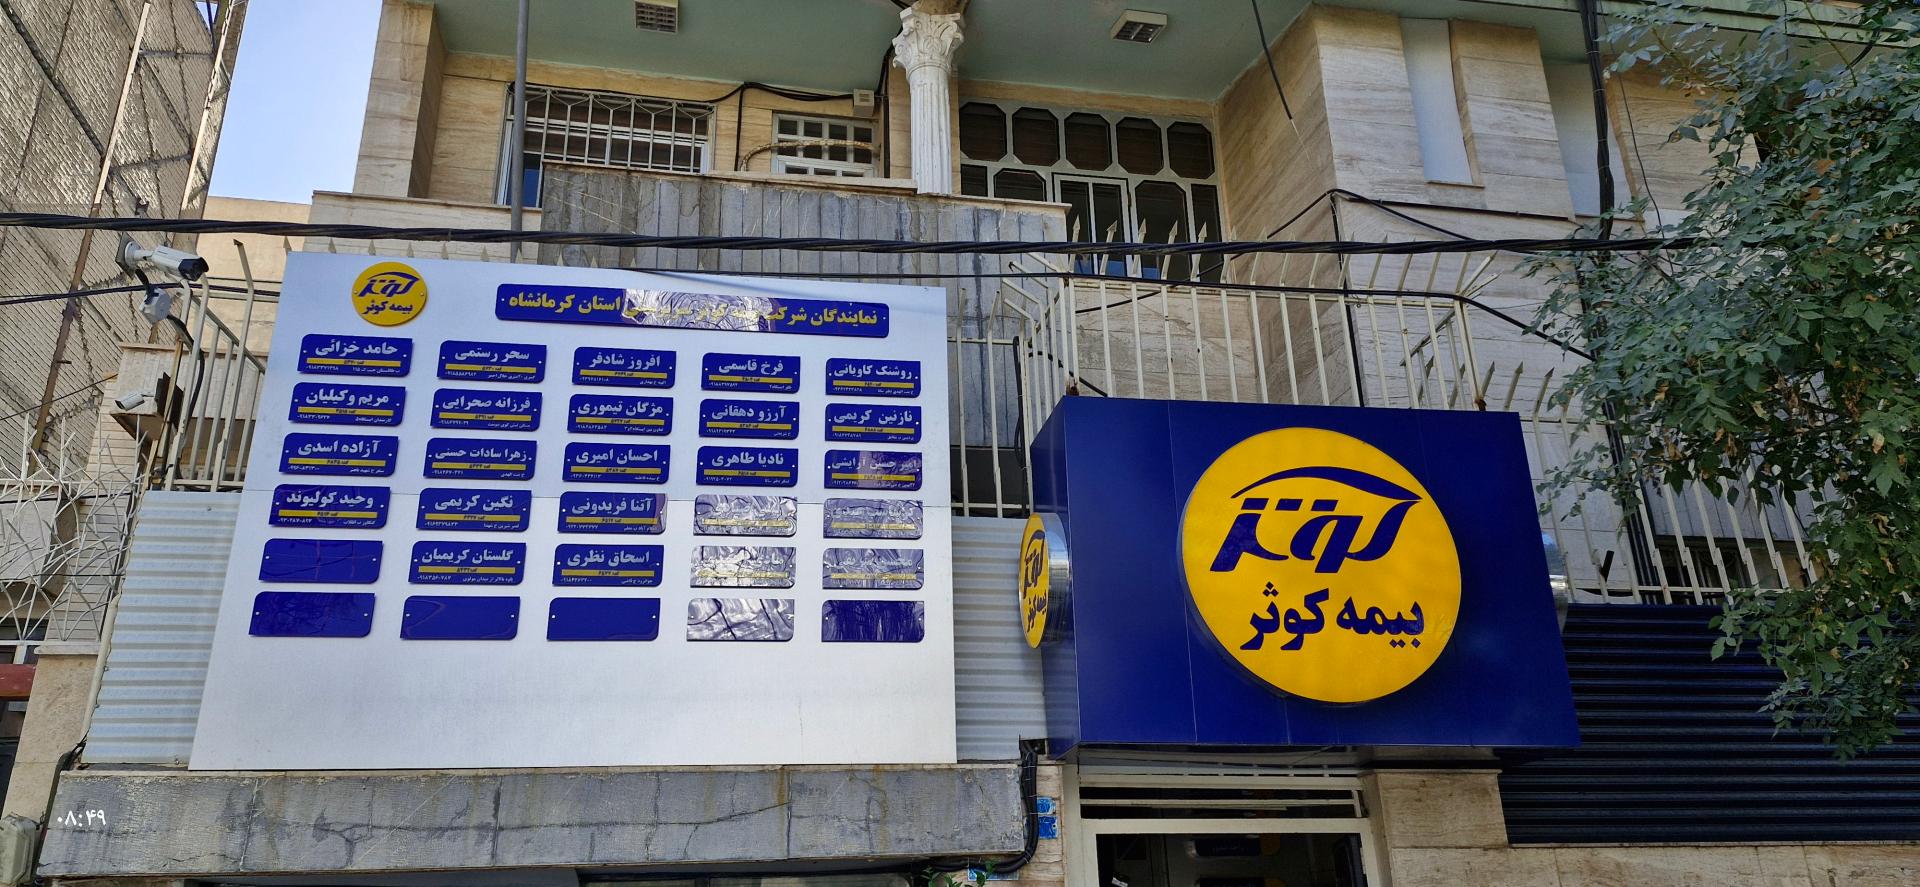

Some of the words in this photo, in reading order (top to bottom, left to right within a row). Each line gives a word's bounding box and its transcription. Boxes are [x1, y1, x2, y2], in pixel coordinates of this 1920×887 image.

[361, 299, 389, 315] کوثر
[389, 303, 413, 315] بیمه
[508, 291, 576, 314] کرمانشاه
[578, 295, 622, 315] استان
[810, 307, 878, 327] نمایندگان
[315, 338, 360, 357] خزائی
[363, 341, 398, 355] حامد
[454, 347, 499, 362] رستمی
[501, 350, 530, 363] سحر
[588, 351, 625, 368] شادفر
[627, 354, 660, 370] افروز
[718, 358, 758, 374] قاسمی
[760, 359, 784, 376] فرخ
[833, 363, 873, 378] کاویانی
[875, 365, 912, 380] روشنک
[358, 394, 389, 407] مریم
[442, 395, 493, 410] صحرایی
[495, 396, 531, 412] فرزانه
[577, 400, 623, 415] تیموری
[625, 400, 663, 417] مژگان
[711, 404, 755, 420] دهقانی
[757, 405, 787, 422] آرزو
[833, 408, 873, 424] کریمی
[878, 409, 913, 426] نازنین
[297, 439, 339, 456] اسدی
[341, 439, 382, 458] آزاده
[434, 447, 467, 459] حسنی
[469, 447, 502, 458] سادات
[504, 448, 528, 462] زهرا
[575, 448, 614, 464] امیری
[616, 448, 658, 465] احسان
[711, 451, 755, 467] طاهری
[758, 452, 784, 468] نادیا
[286, 490, 338, 508] کولیوند
[339, 494, 374, 509] وحید
[434, 494, 481, 511] کریمی
[482, 495, 514, 512] نگین
[571, 497, 627, 515] فریدونی
[630, 497, 654, 512] آتنا
[421, 547, 471, 564] کریمیان
[471, 548, 514, 565] گلستان
[567, 549, 606, 567] نظری
[607, 550, 650, 567] اسحاق
[1239, 580, 1330, 651] کوثر
[1336, 595, 1425, 649] بیمه
